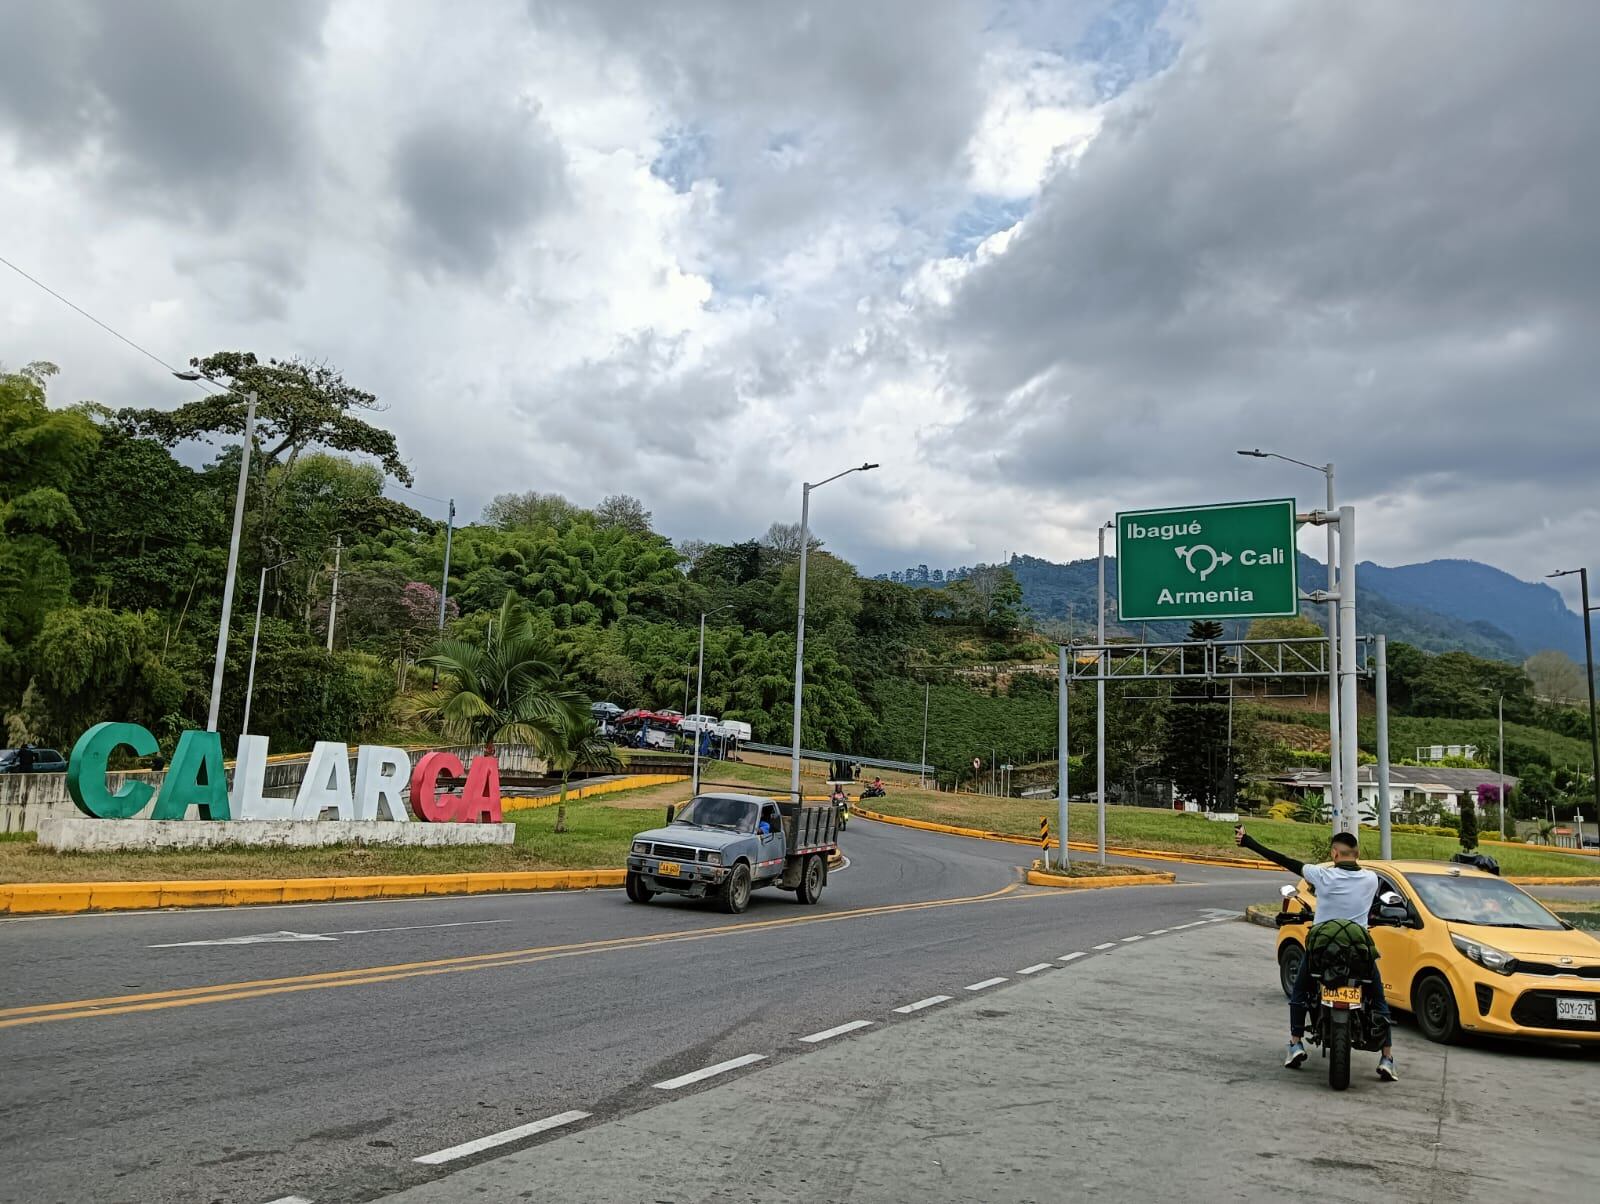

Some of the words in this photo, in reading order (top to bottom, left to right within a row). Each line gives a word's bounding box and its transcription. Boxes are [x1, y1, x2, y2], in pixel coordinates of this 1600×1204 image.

[1127, 519, 1202, 540] Ibagué
[1239, 547, 1284, 566] Cali
[1156, 587, 1254, 605] Armenia
[66, 721, 503, 823] CALARCA
[1558, 1002, 1594, 1015] SOY-275
